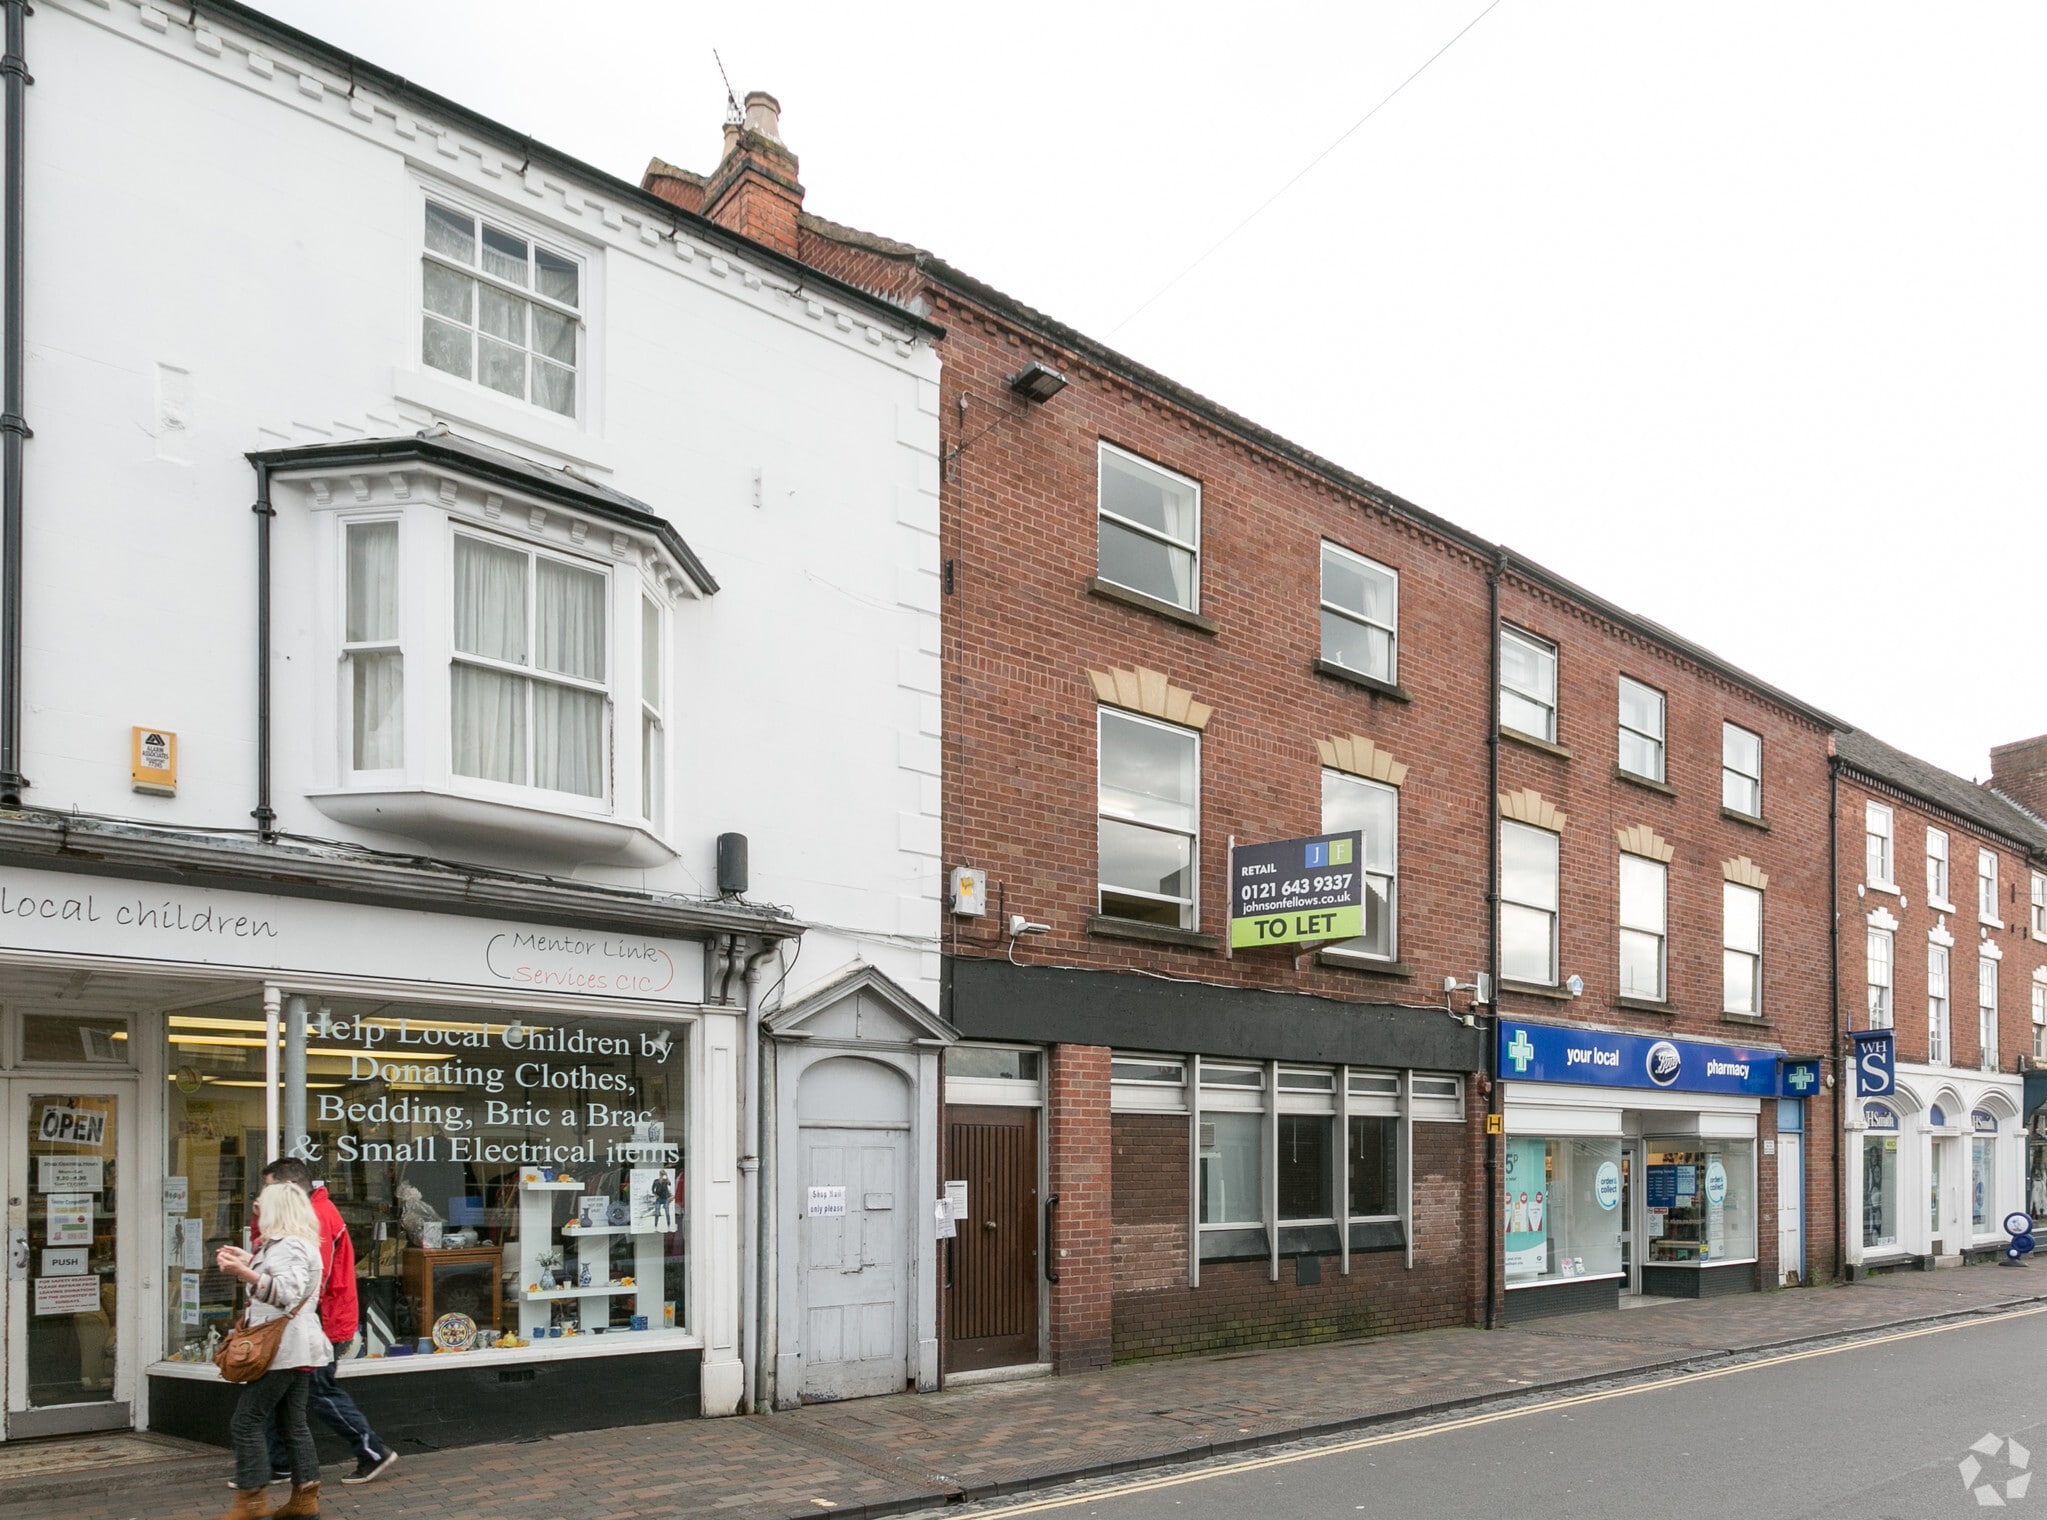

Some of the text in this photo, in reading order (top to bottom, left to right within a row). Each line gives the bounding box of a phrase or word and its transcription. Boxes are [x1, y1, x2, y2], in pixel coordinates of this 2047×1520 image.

[1241, 863, 1277, 877] RETAIL
[1241, 873, 1353, 900] 0121 643 9337
[1242, 890, 1351, 915] johnsonfellows.co.uk
[116, 900, 278, 938] children
[1254, 913, 1337, 939] TO LET
[513, 932, 658, 963] Mentor Link
[512, 966, 653, 992] Services CIC
[301, 1011, 673, 1063] Help Local Children by
[1860, 1040, 1888, 1054] WH
[349, 1055, 636, 1097] Donating Clothes,
[1567, 1048, 1593, 1066] your
[1594, 1046, 1619, 1067] local
[1707, 1058, 1750, 1080] pharmacy
[1861, 1053, 1890, 1093] S
[43, 1111, 104, 1143] OPEN
[317, 1094, 653, 1131] Bedding, Bric a Brac
[289, 1134, 680, 1165] & Small Electrical items
[51, 1258, 79, 1266] PUSH
